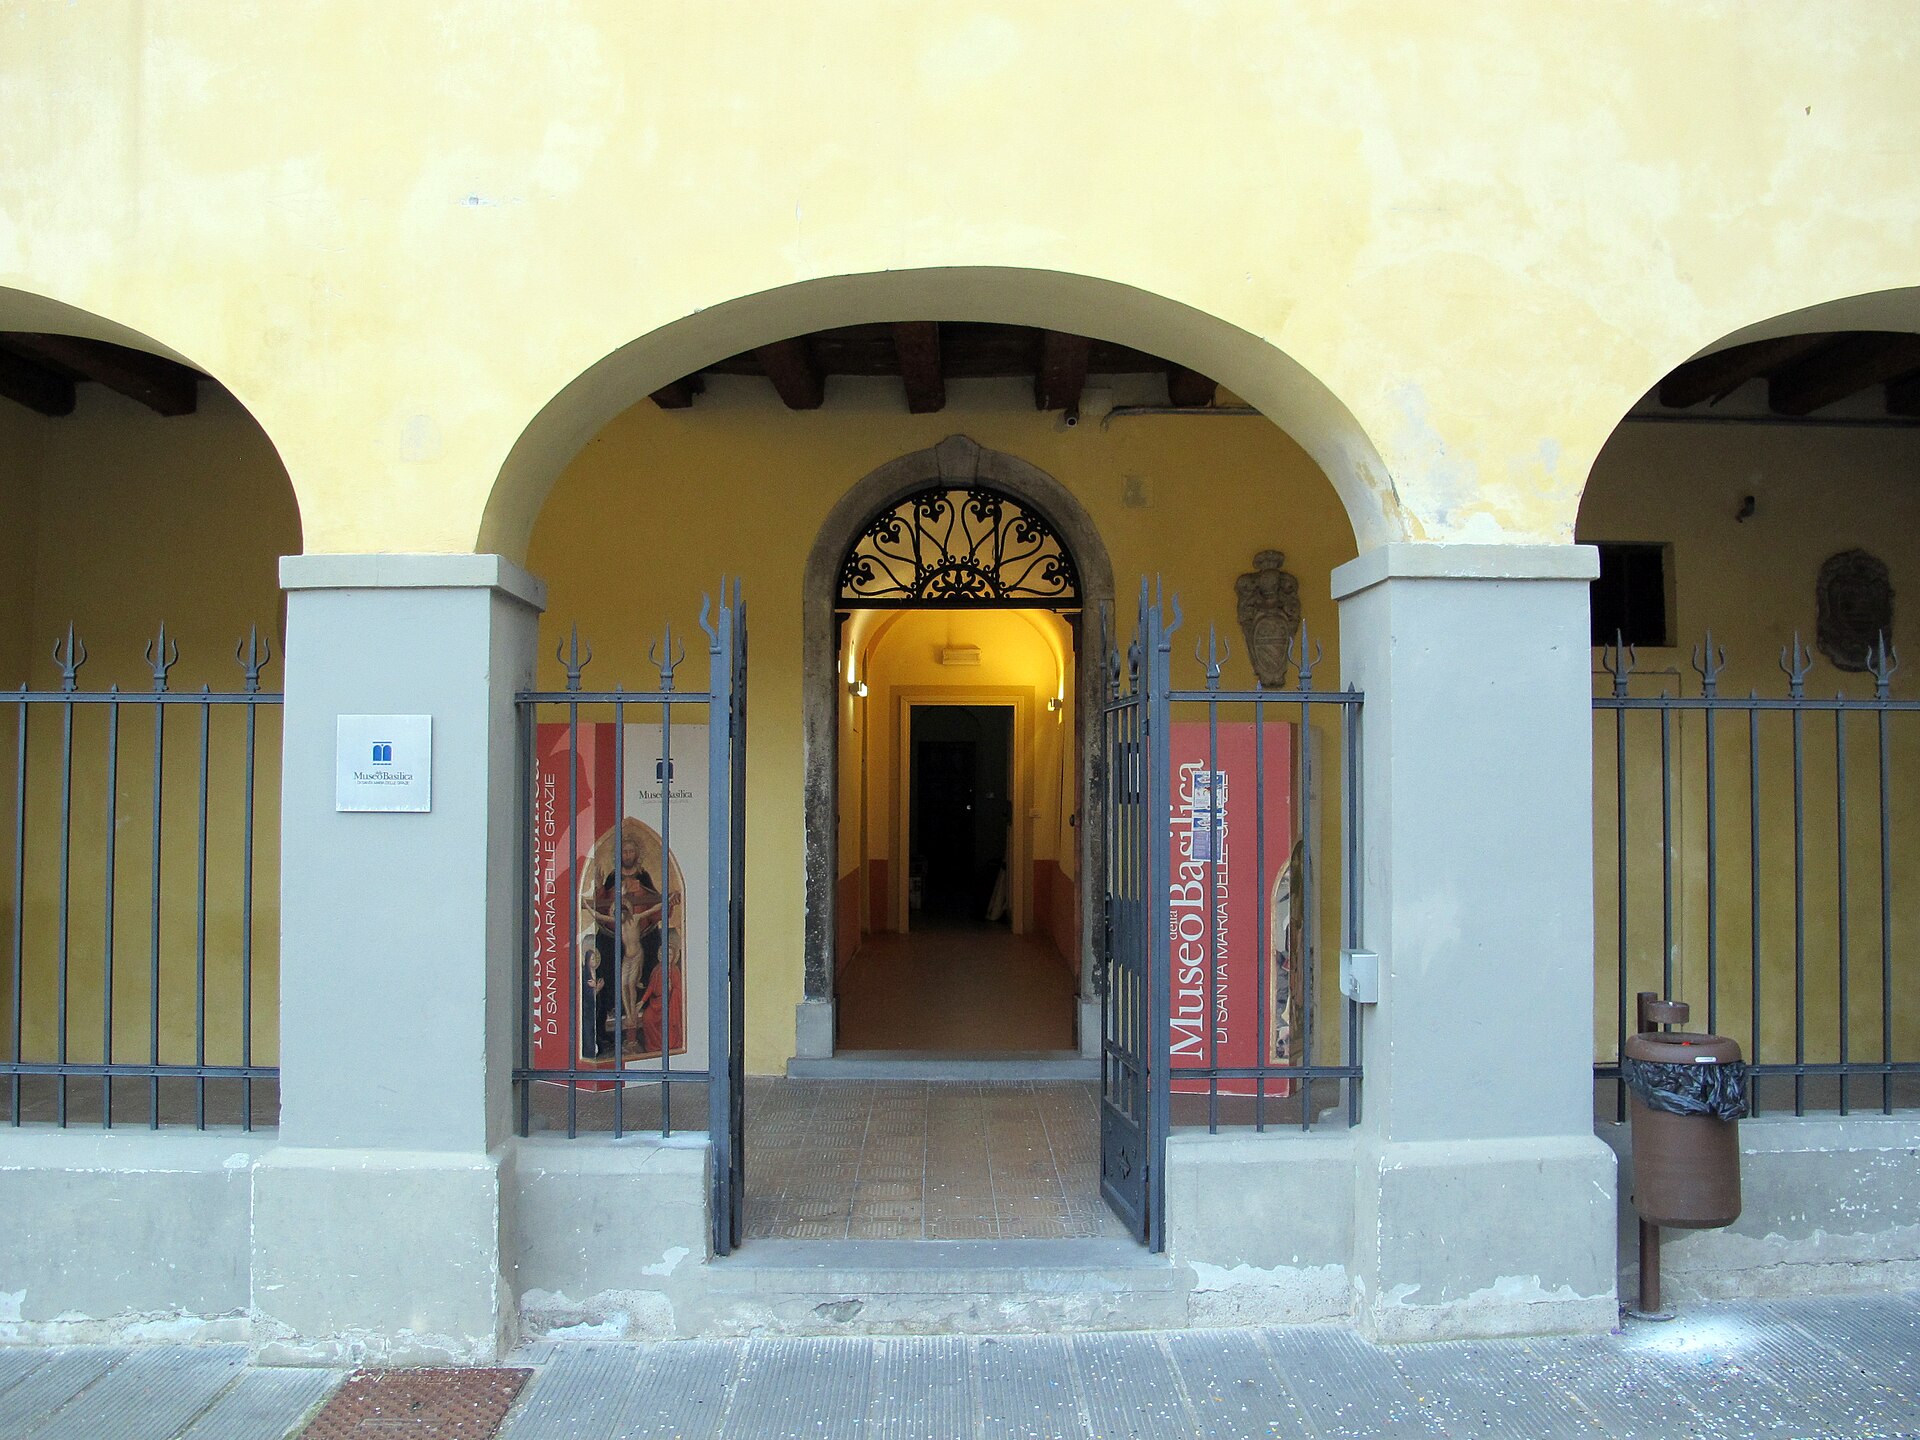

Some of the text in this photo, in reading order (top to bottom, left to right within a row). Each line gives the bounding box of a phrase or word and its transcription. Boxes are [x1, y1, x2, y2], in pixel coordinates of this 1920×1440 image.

[544, 773, 558, 1035] DI SANTA MARIA DELLE GRAZIE
[1216, 902, 1229, 959] MARIA
[1216, 1027, 1228, 1044] DI
